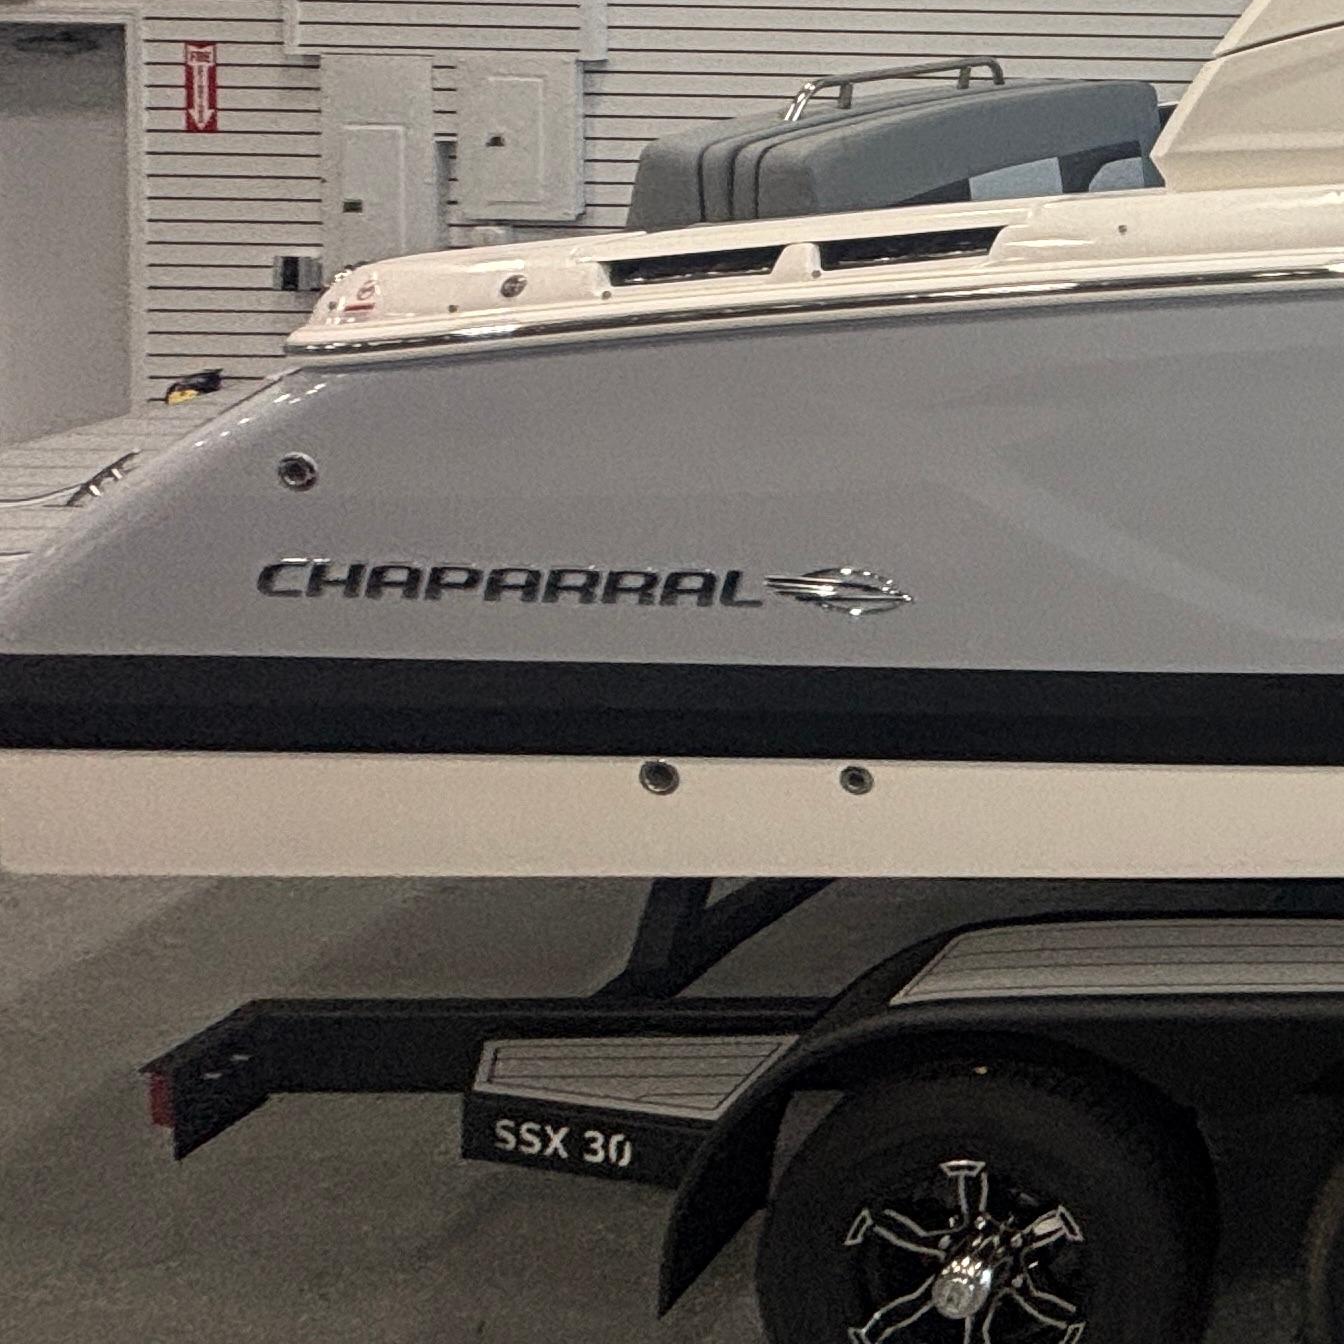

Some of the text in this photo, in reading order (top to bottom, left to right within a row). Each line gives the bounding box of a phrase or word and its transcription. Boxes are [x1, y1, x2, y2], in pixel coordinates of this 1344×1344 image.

[256, 556, 764, 608] CHAPARRAL
[494, 1118, 633, 1167] SSX 30
